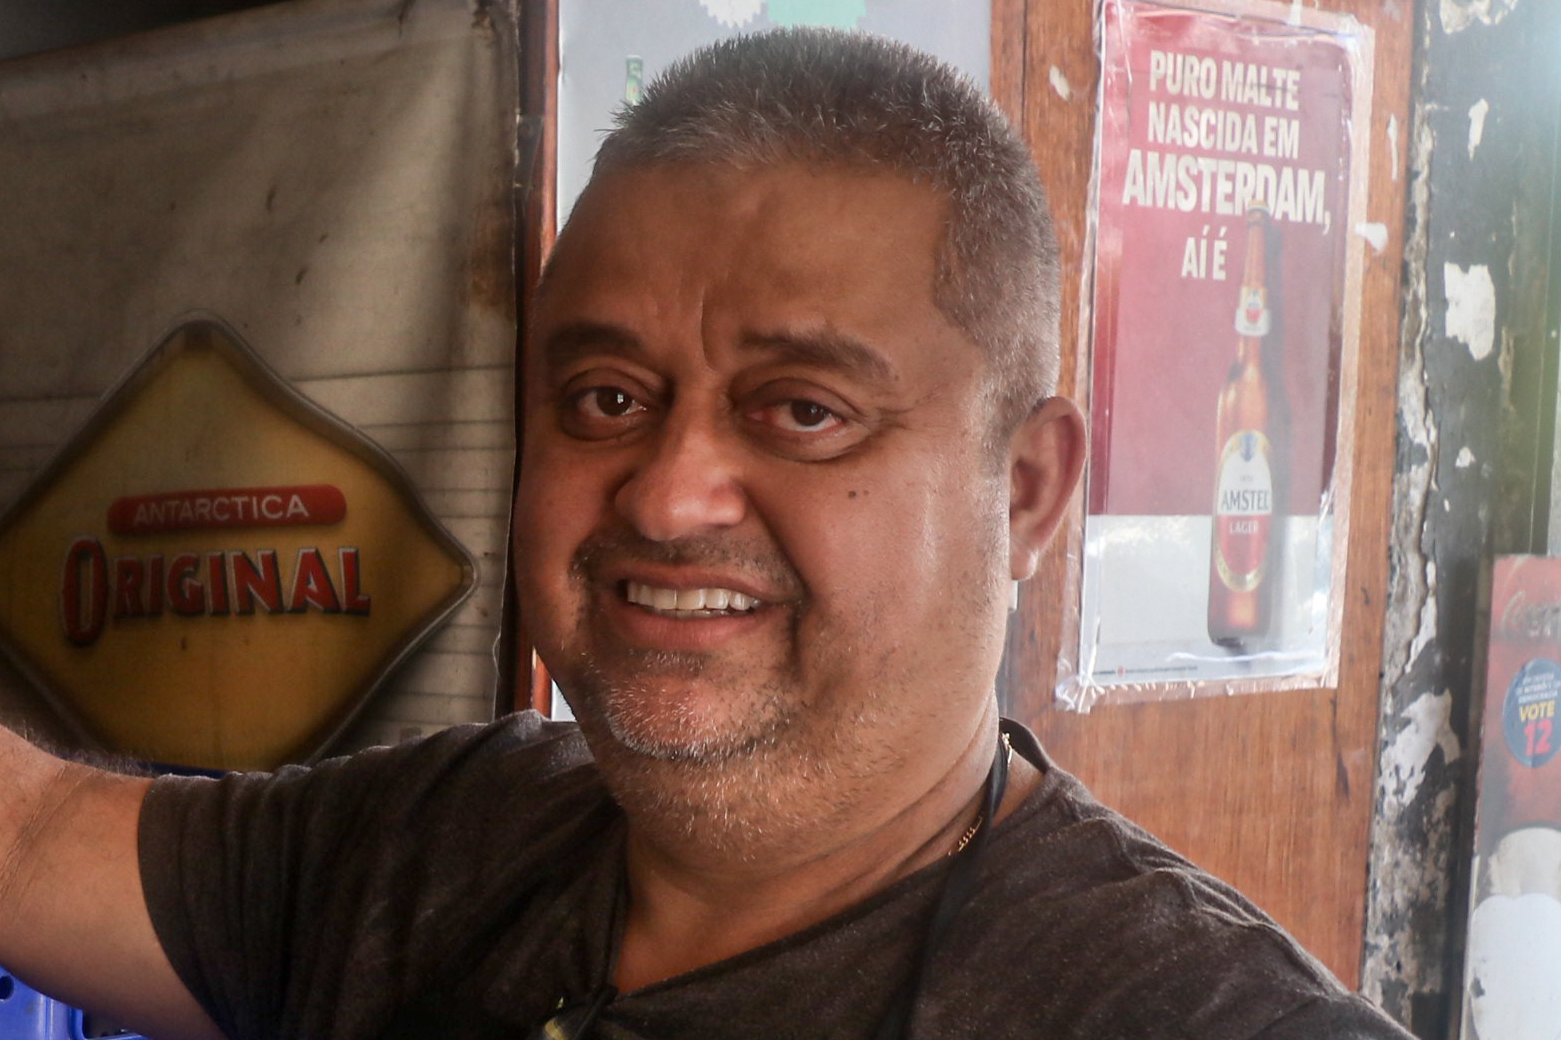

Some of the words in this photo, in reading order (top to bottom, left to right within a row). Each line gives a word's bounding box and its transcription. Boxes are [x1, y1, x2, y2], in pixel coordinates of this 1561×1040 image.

[1150, 49, 1217, 100] PURO
[1221, 59, 1301, 111] MALTE
[1147, 100, 1258, 155] NASCIDA
[1263, 115, 1300, 160] EM
[1121, 147, 1332, 236] AMSTERDAM,
[1180, 224, 1210, 280] AÍ
[1212, 226, 1228, 281] É
[132, 493, 310, 526] ANTARCTICA
[1220, 489, 1271, 511] AMSTEL
[1229, 520, 1260, 536] LAGER
[1518, 700, 1556, 722] VOTE
[1523, 718, 1553, 757] 12
